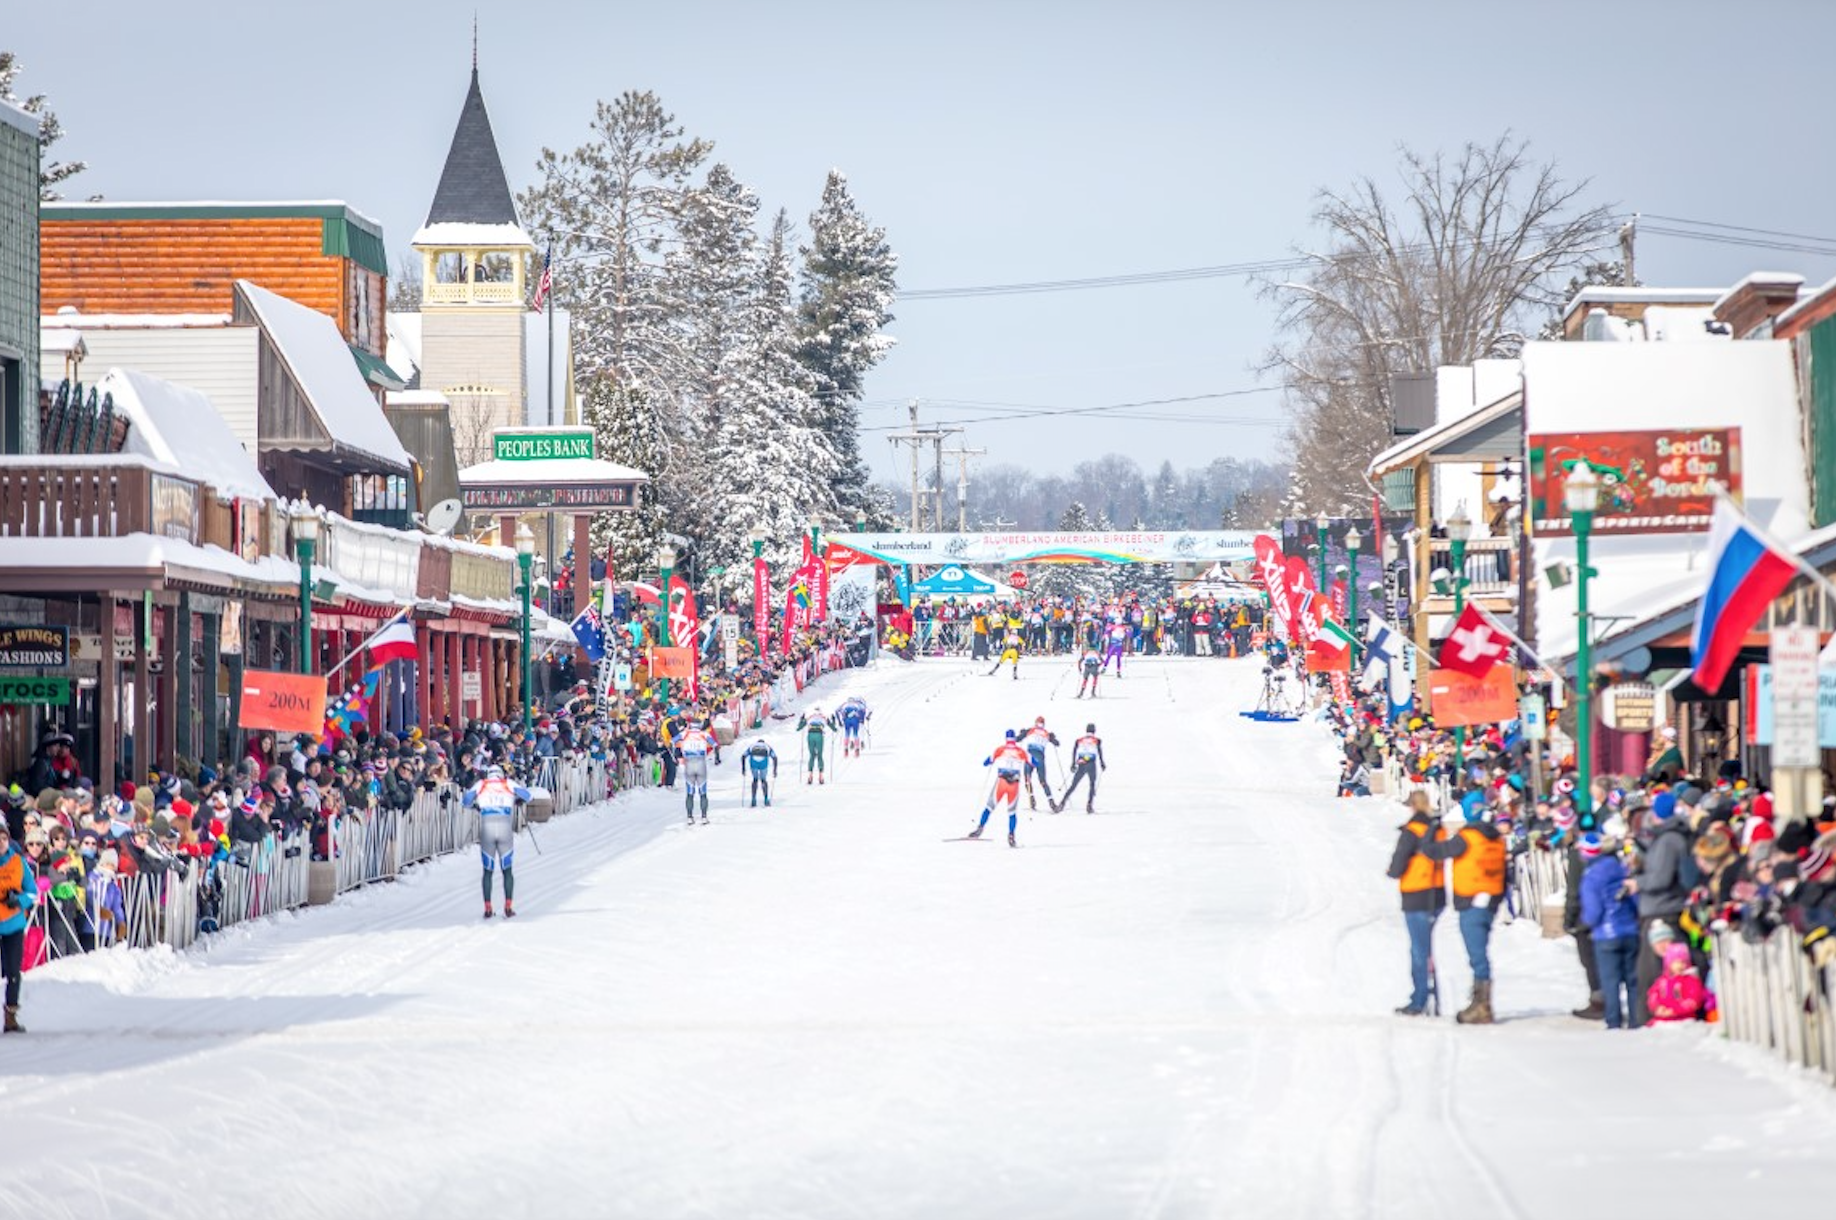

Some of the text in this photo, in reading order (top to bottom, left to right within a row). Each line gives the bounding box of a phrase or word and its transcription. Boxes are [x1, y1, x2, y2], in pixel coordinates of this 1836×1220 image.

[498, 439, 589, 457] PEOPLES BANK
[1656, 434, 1722, 457] South
[1659, 456, 1717, 476] of the
[872, 541, 932, 550] slumberland
[983, 534, 1165, 545] SLUMBERLAND AMERICAN BIRKEBEINER
[15, 628, 62, 648] WINGS
[725, 629, 736, 638] 15
[0, 682, 59, 698] rocs
[268, 690, 311, 711] 200M
